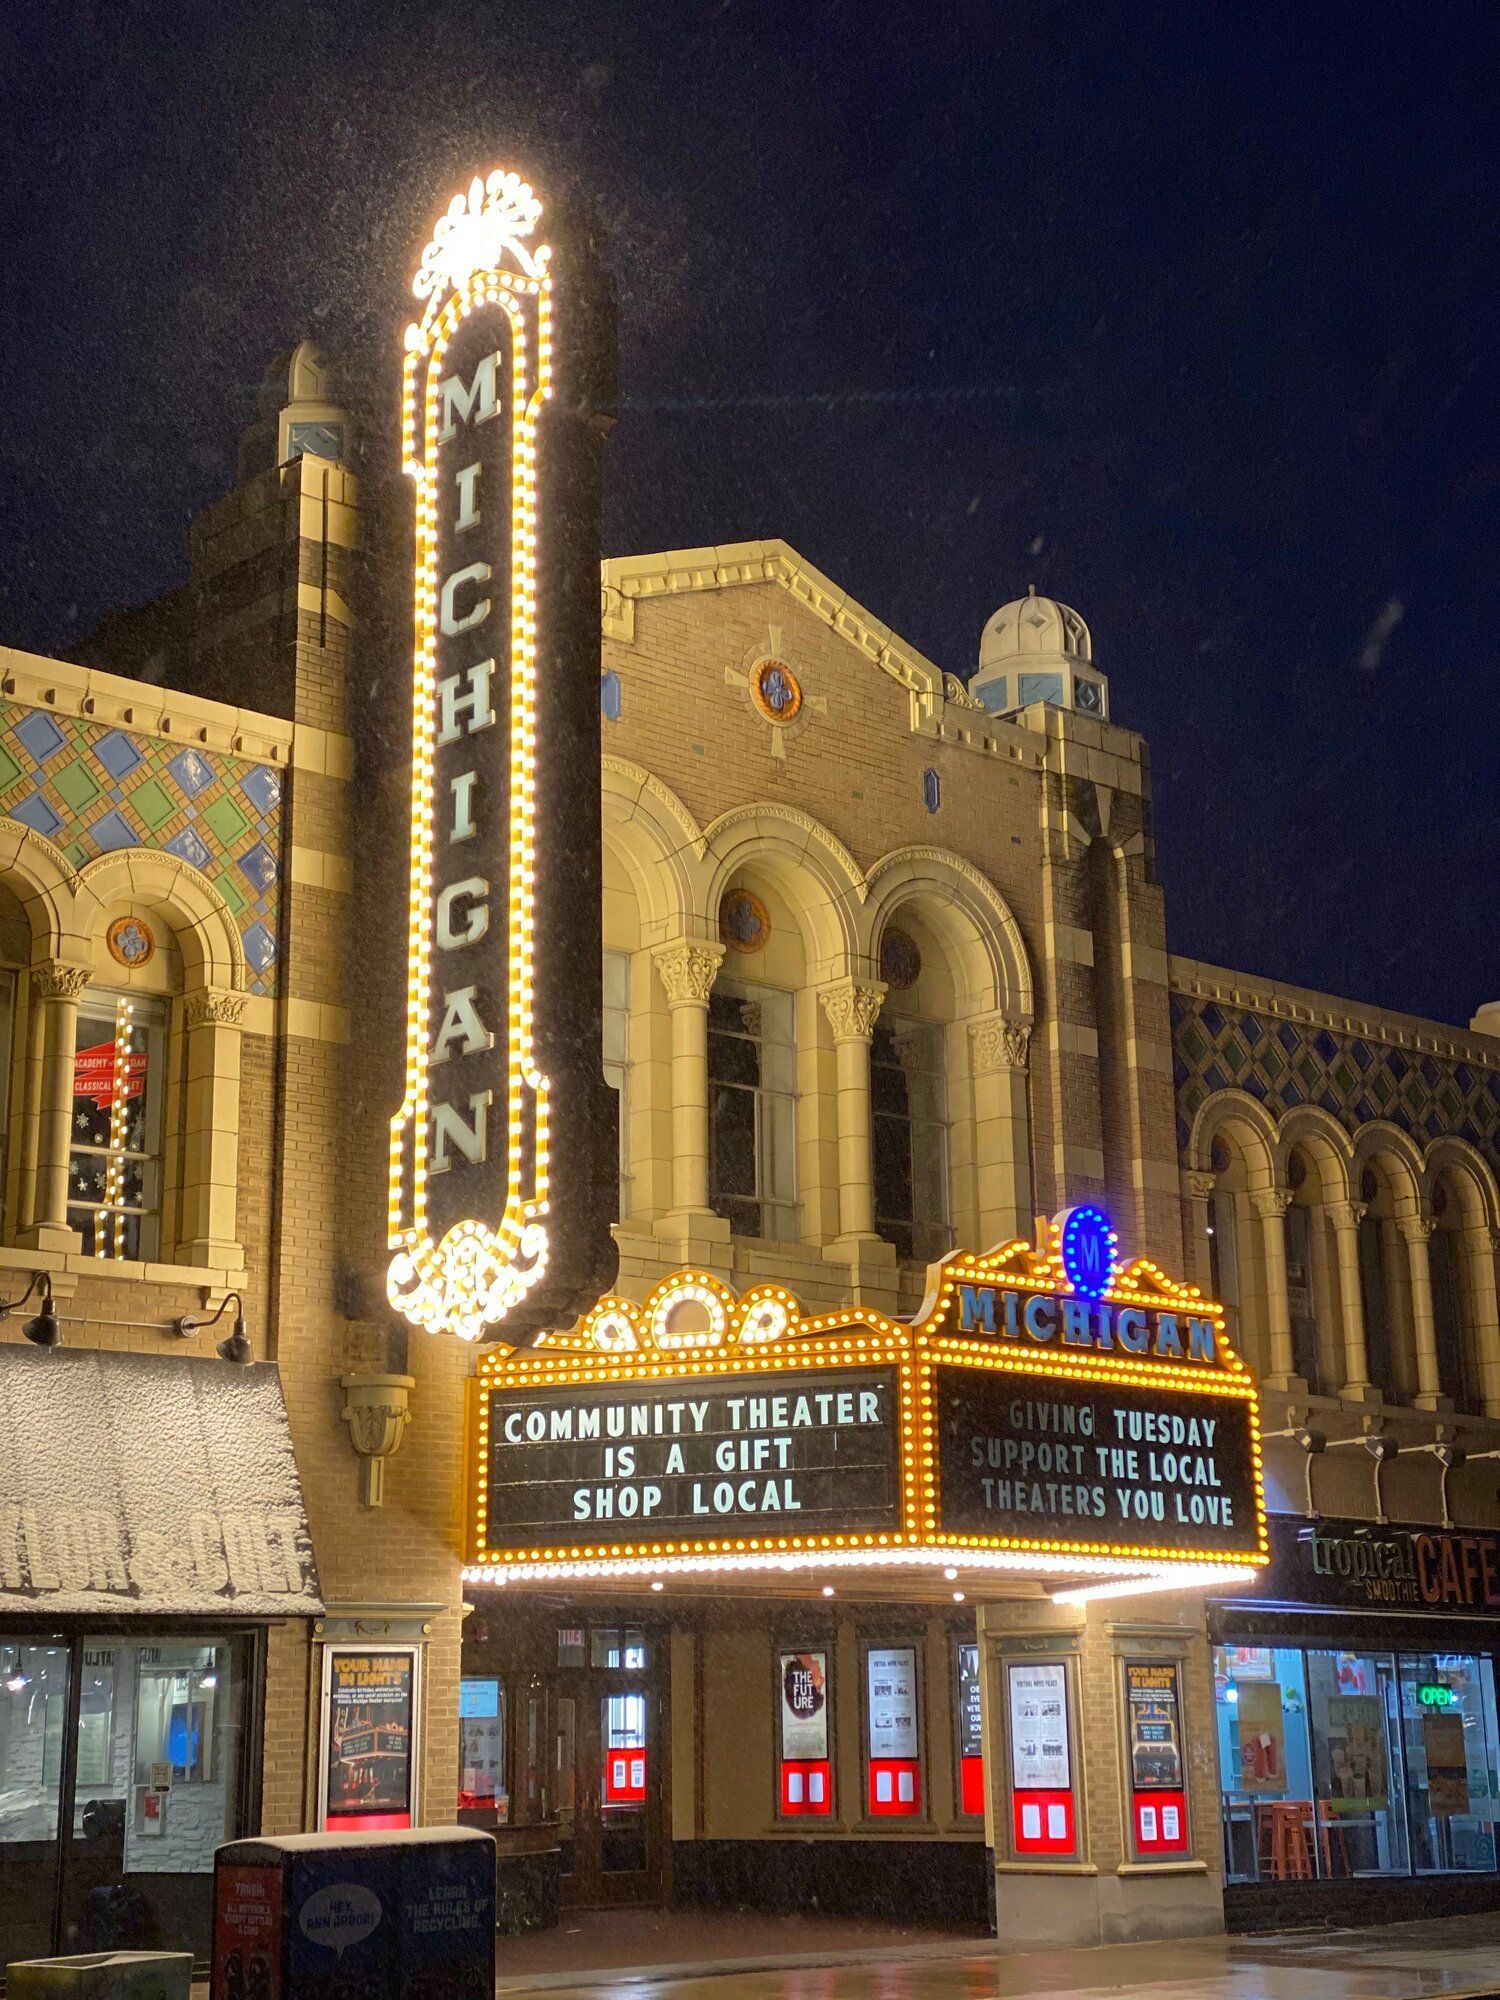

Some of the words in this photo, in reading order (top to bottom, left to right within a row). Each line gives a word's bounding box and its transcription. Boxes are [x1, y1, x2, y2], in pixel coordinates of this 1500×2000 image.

[429, 350, 504, 1176] MICHIGAN
[76, 1058, 107, 1068] ACADEMY
[75, 1081, 111, 1091] CLASSICAL
[1081, 1234, 1100, 1274] M
[957, 1284, 1215, 1362] MICHIGAN
[504, 1401, 709, 1443] COMMUNITY
[726, 1391, 880, 1431] THEATER
[1009, 1399, 1093, 1436] GIVING
[1114, 1409, 1216, 1448] TUESDAY
[605, 1447, 635, 1478] IS
[666, 1443, 685, 1475] A
[716, 1437, 793, 1471] GIFT
[970, 1436, 1084, 1475] SUPPORT
[1096, 1447, 1138, 1480] THE
[1150, 1452, 1221, 1487] LOCAL
[574, 1486, 662, 1520] SHOP
[693, 1479, 801, 1515] LOCAL
[981, 1478, 1106, 1518] THEATERS
[1118, 1488, 1164, 1522] YOU
[1177, 1493, 1234, 1526] LOVE
[1307, 1528, 1417, 1587] tropical
[1414, 1533, 1500, 1605] CAFE
[1366, 1578, 1419, 1602] SMOOTHIE
[334, 1658, 370, 1672] YOUR
[372, 1658, 410, 1672] NAME
[793, 1671, 812, 1682] THE
[339, 1672, 354, 1686] IN
[357, 1672, 402, 1686] LIGHTS
[794, 1684, 812, 1696] FUT
[794, 1697, 813, 1708] URE
[1421, 1686, 1453, 1705] OPEN
[428, 1886, 467, 1900] LEARN
[408, 1904, 430, 1917] THE
[434, 1901, 470, 1915] RULES
[474, 1898, 488, 1913] OF
